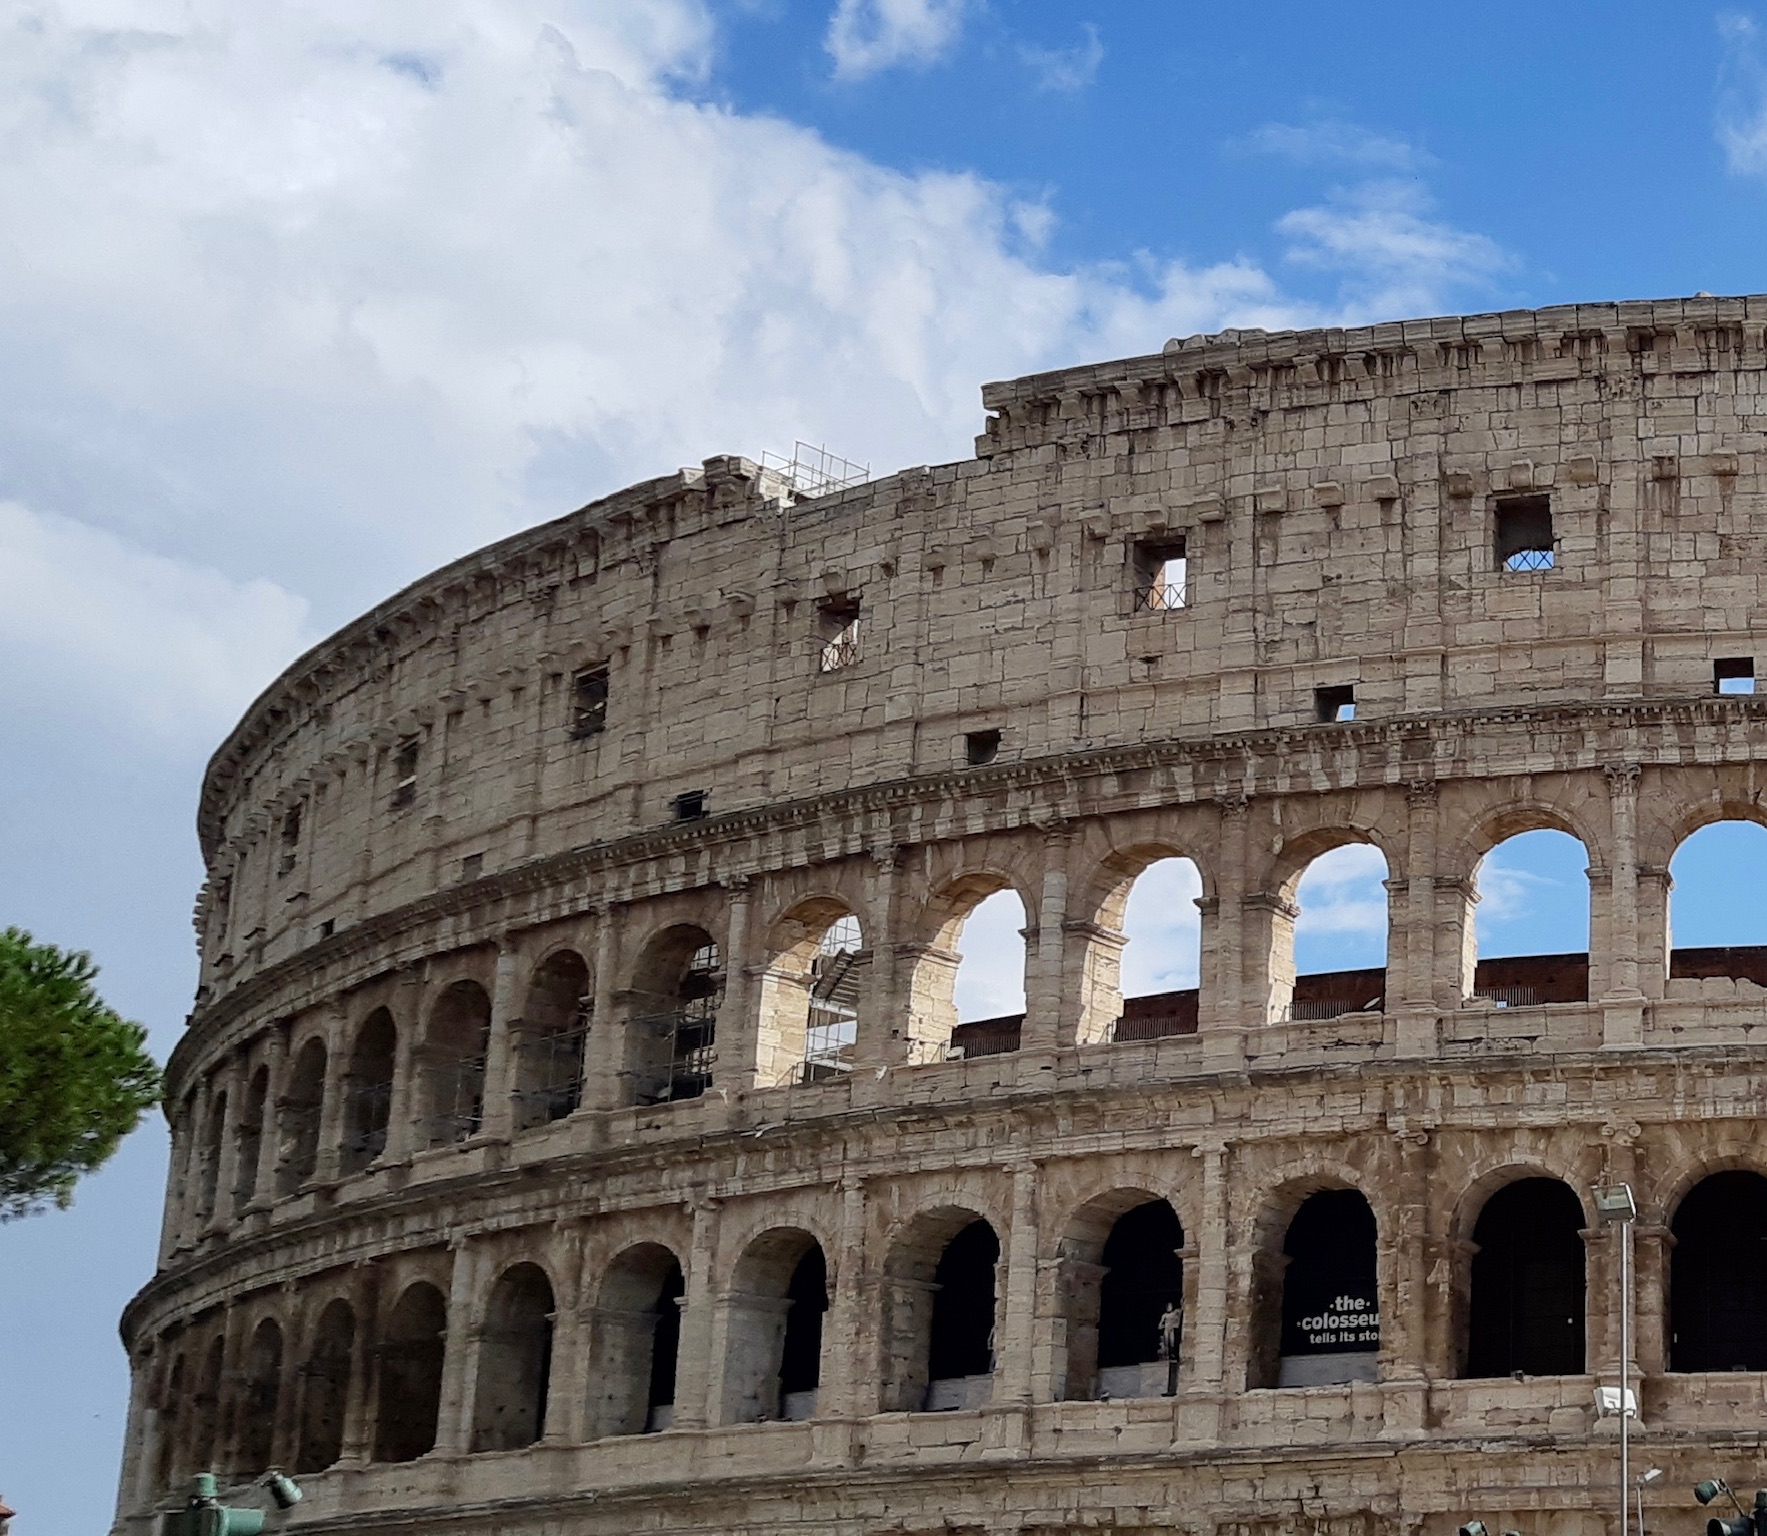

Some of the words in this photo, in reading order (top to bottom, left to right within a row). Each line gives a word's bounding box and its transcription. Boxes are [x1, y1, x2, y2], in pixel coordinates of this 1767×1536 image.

[1309, 1332, 1337, 1344] tells
[1339, 1331, 1356, 1342] its
[1358, 1330, 1379, 1342] sto
